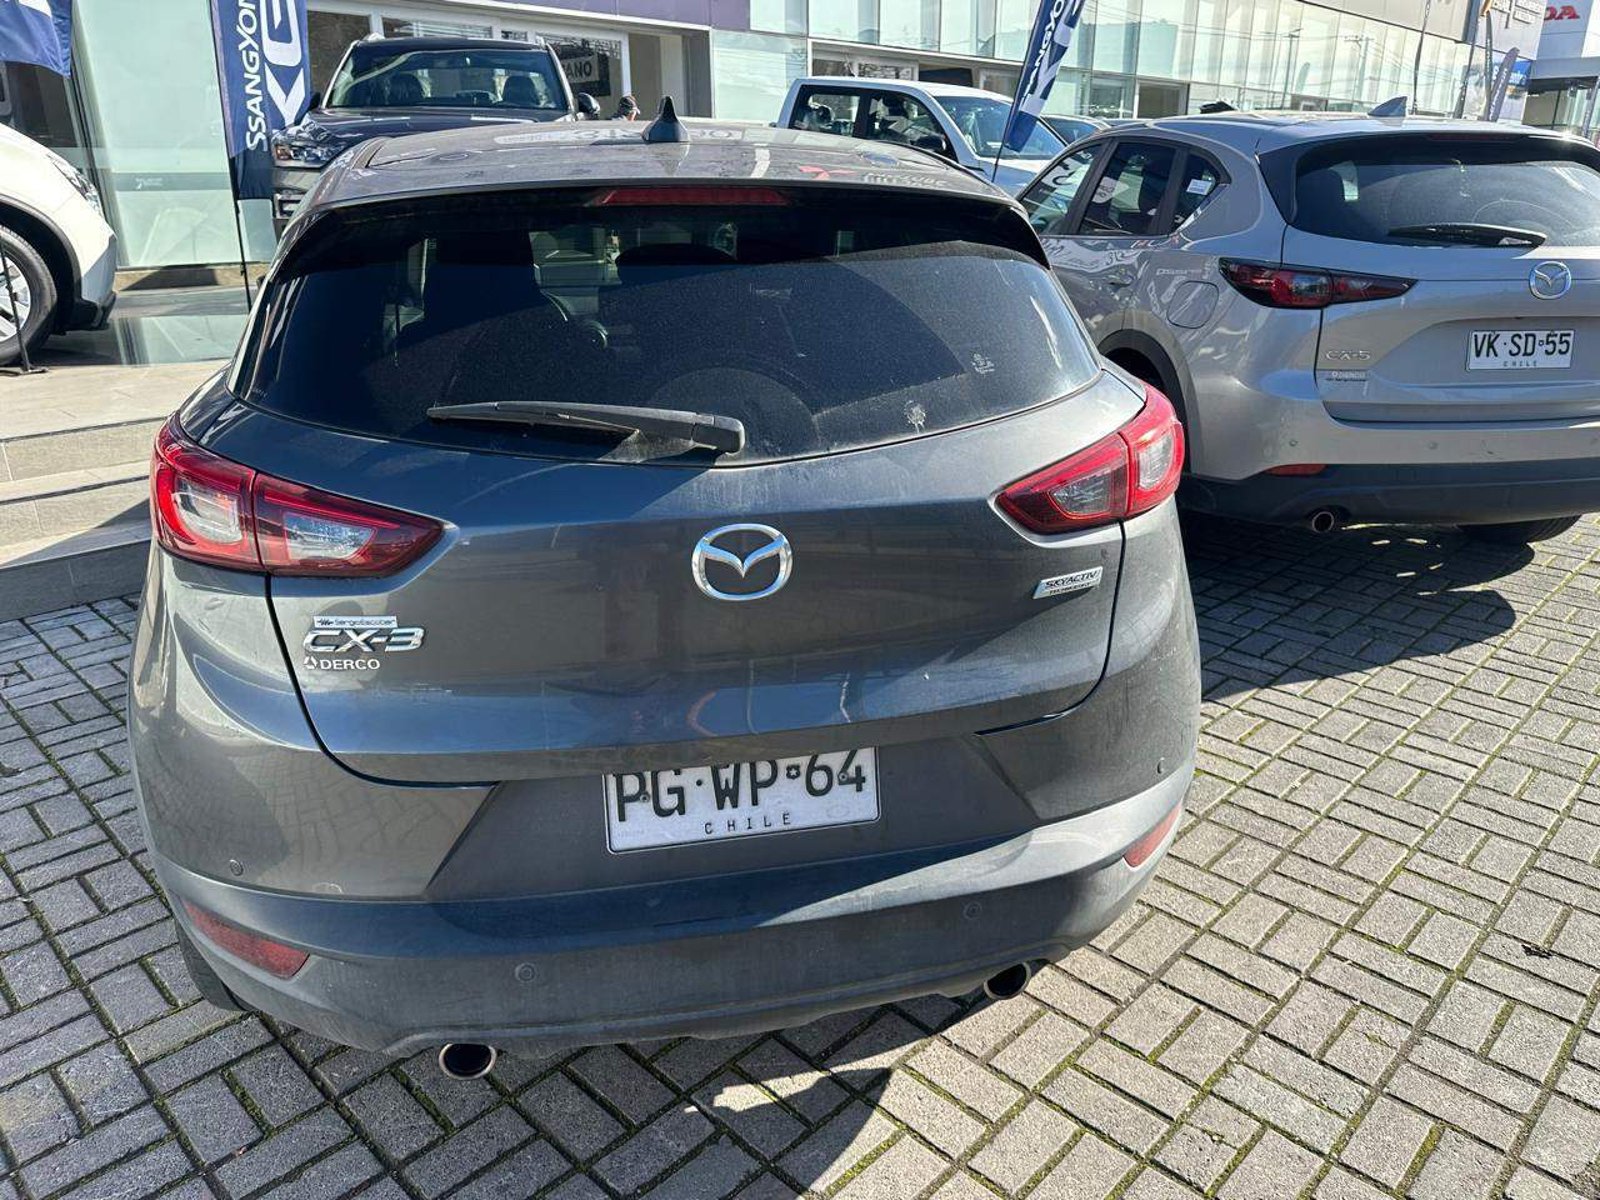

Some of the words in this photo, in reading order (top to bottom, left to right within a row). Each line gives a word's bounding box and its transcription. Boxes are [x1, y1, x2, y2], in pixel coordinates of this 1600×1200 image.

[562, 60, 593, 79] ANO
[1326, 350, 1371, 361] CX-5
[1046, 571, 1097, 586] SKYACTIV
[303, 627, 425, 653] CX-3
[320, 659, 380, 670] DERCO
[704, 811, 792, 835] CHILE
